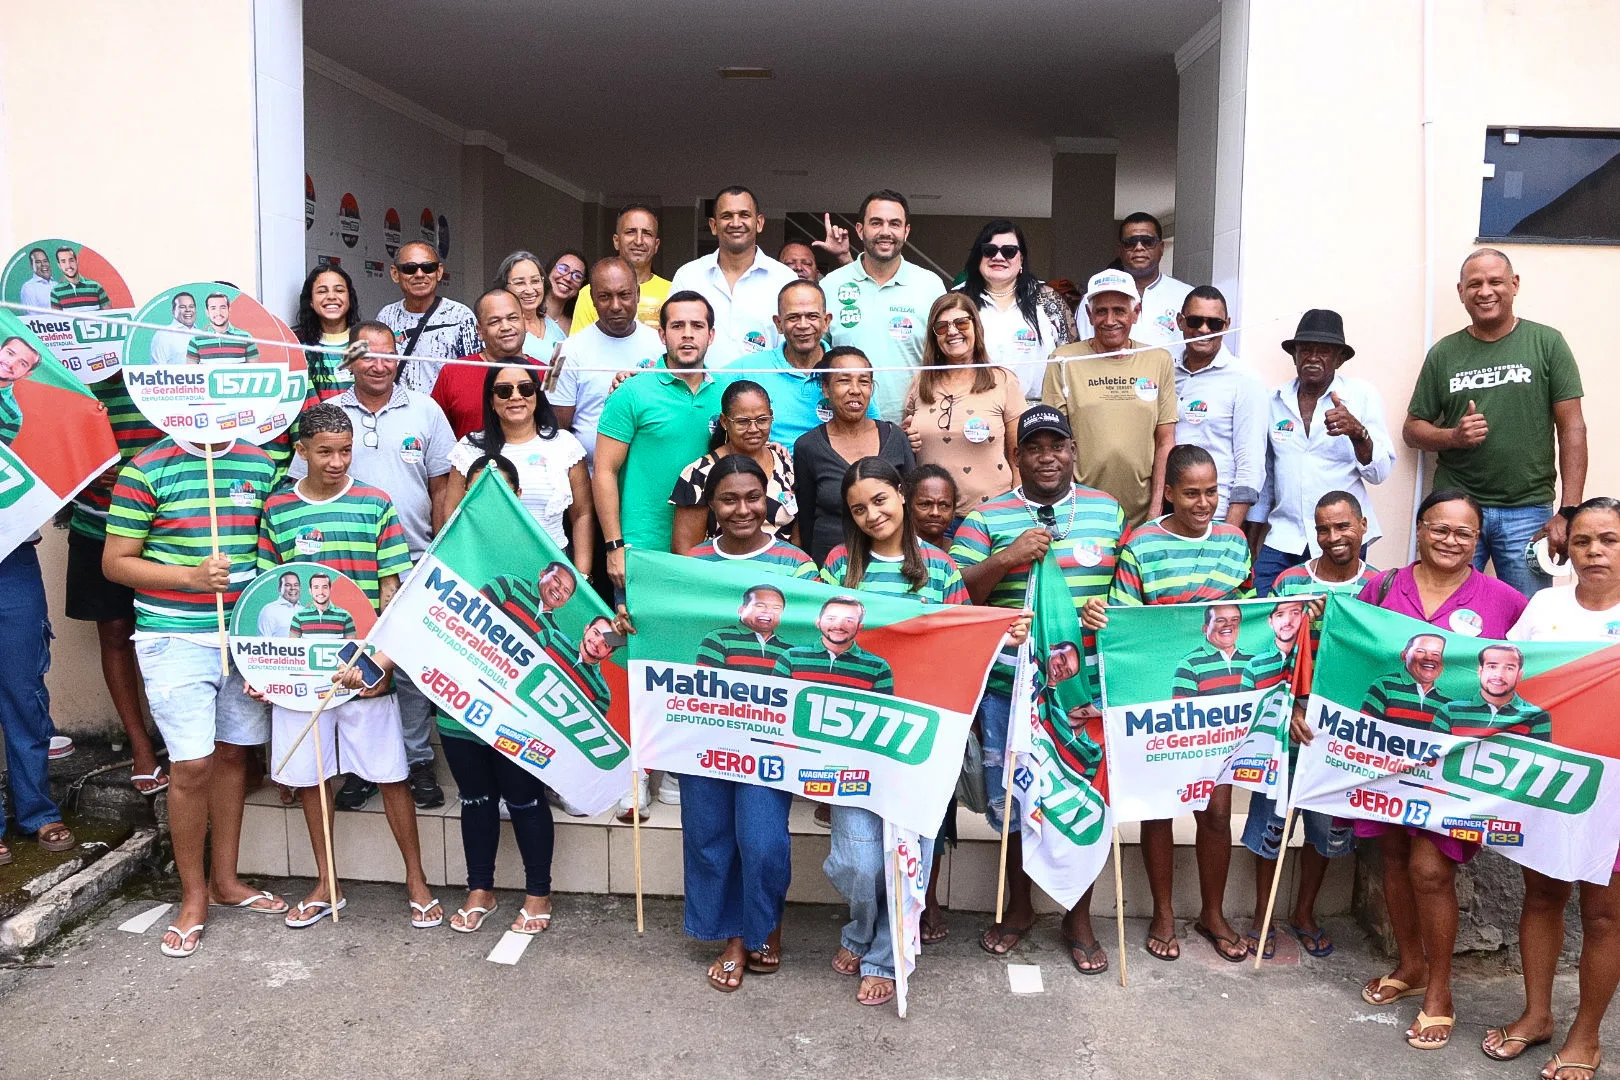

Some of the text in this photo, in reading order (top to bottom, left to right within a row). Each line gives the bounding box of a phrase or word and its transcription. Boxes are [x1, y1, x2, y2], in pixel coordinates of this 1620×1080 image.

[26, 319, 71, 334] theus
[128, 368, 205, 386] Matheus
[1088, 376, 1127, 387] Athletic
[1449, 367, 1531, 394] BACELAR
[1455, 362, 1524, 378] DEPUTADO FEDERAL
[141, 385, 206, 396] de Geraldinho
[212, 372, 277, 395] 15777
[163, 415, 193, 428] JERO
[198, 415, 208, 427] 13
[424, 566, 536, 667] Matheus
[236, 642, 306, 657] Matheus
[422, 615, 468, 657] DEPUTADO
[467, 650, 509, 690] ESTADUAL
[428, 604, 519, 680] de Geraldinho
[247, 656, 306, 666] de Geraldinho
[247, 664, 277, 672] DEPUTADO
[266, 683, 293, 695] JERO
[296, 684, 306, 695] 13
[421, 668, 470, 710] JERO
[467, 702, 491, 725] 13
[646, 665, 788, 707] Matheus
[529, 669, 622, 759] 15777
[666, 696, 786, 724] de Geraldinho
[1125, 701, 1253, 737] Matheus
[666, 713, 784, 736] DEPUTADO ESTADUAL
[806, 693, 928, 755] 15777
[1318, 704, 1442, 763] Matheus
[497, 726, 554, 756] WAGNER RUI
[1146, 725, 1248, 751] de Geraldinho
[1327, 740, 1343, 755] de
[498, 736, 547, 765] 130 133
[1146, 748, 1203, 763] DEPUTADO
[700, 749, 782, 780] JERO 13
[800, 770, 866, 781] WAGNER RUI
[1236, 768, 1260, 780] 130
[1325, 755, 1375, 780] DEPUTADO
[1459, 741, 1590, 805] 15777
[806, 782, 867, 793] 130 133
[1181, 780, 1216, 803] JER
[1350, 788, 1430, 825] JERO 13
[1443, 817, 1516, 833] WAGNER RUI
[1450, 829, 1519, 845] 130 133
